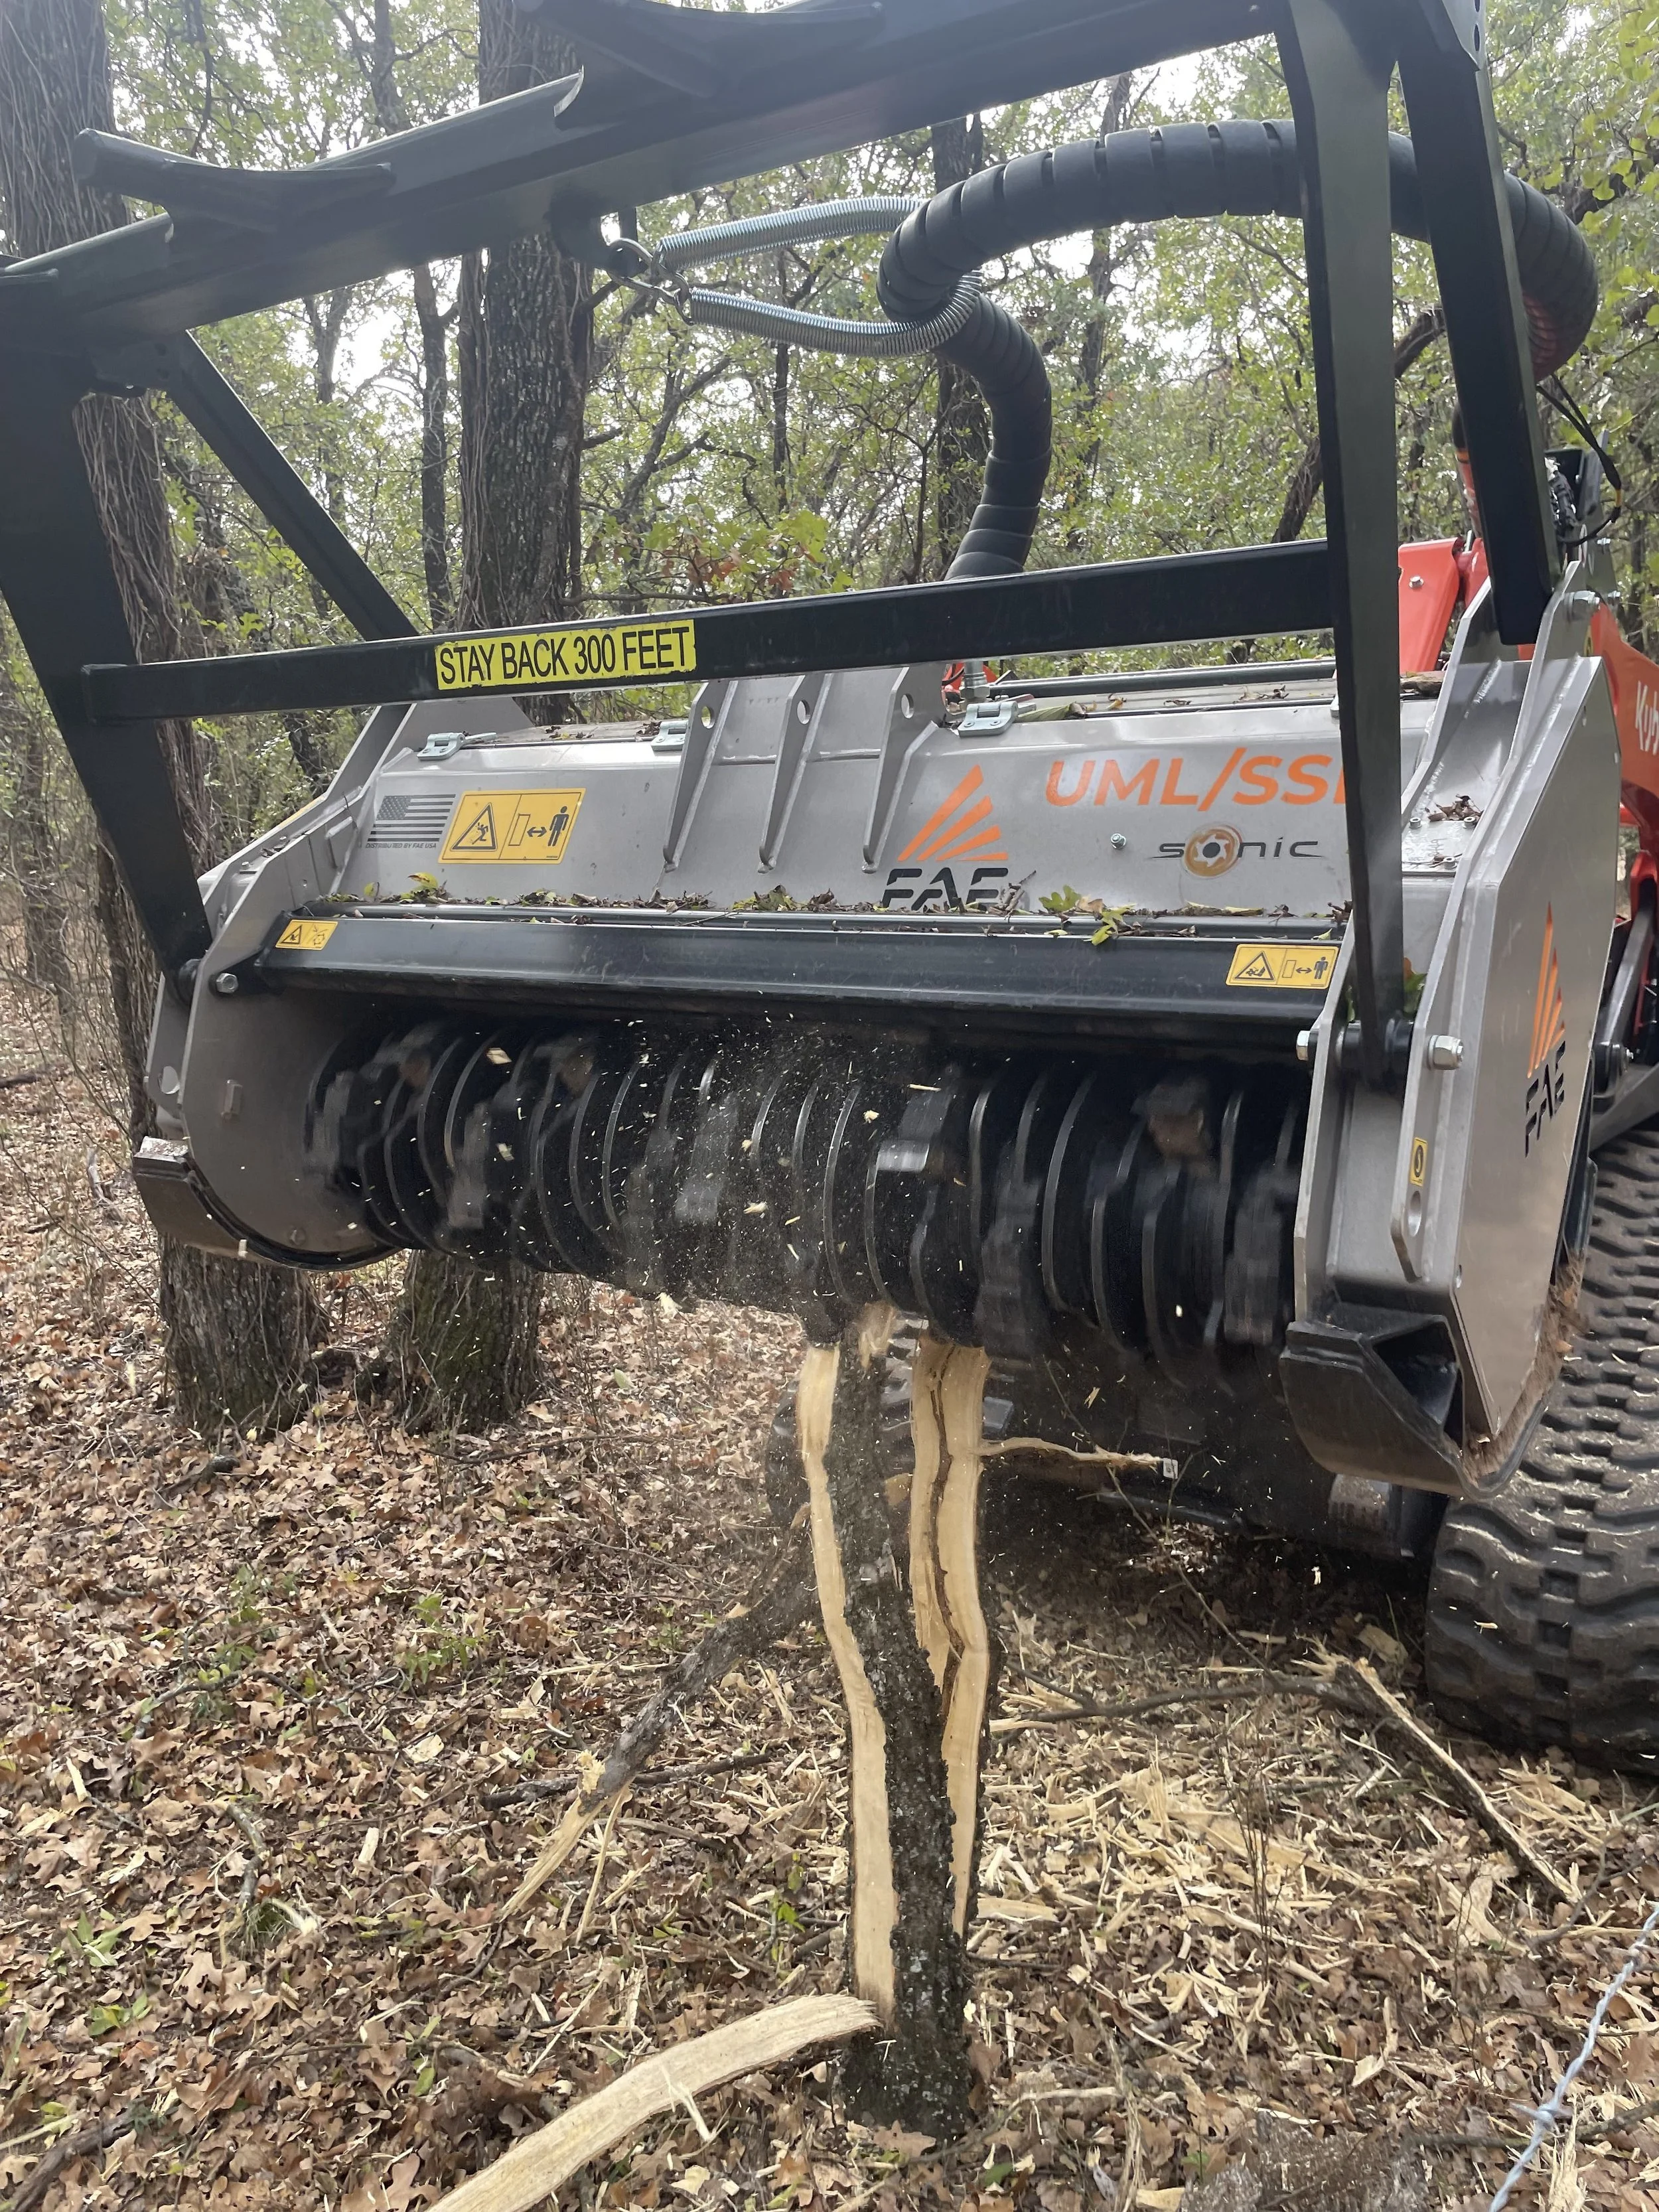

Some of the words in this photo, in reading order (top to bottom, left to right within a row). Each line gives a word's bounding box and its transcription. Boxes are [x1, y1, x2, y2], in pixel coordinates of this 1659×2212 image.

[441, 643, 495, 684] STAY
[502, 638, 569, 679] BACK
[573, 634, 615, 674] 300
[622, 627, 689, 670] FEET
[1150, 823, 1326, 877] sonic
[882, 867, 1009, 912] FAE
[1526, 1041, 1566, 1158] FAE
